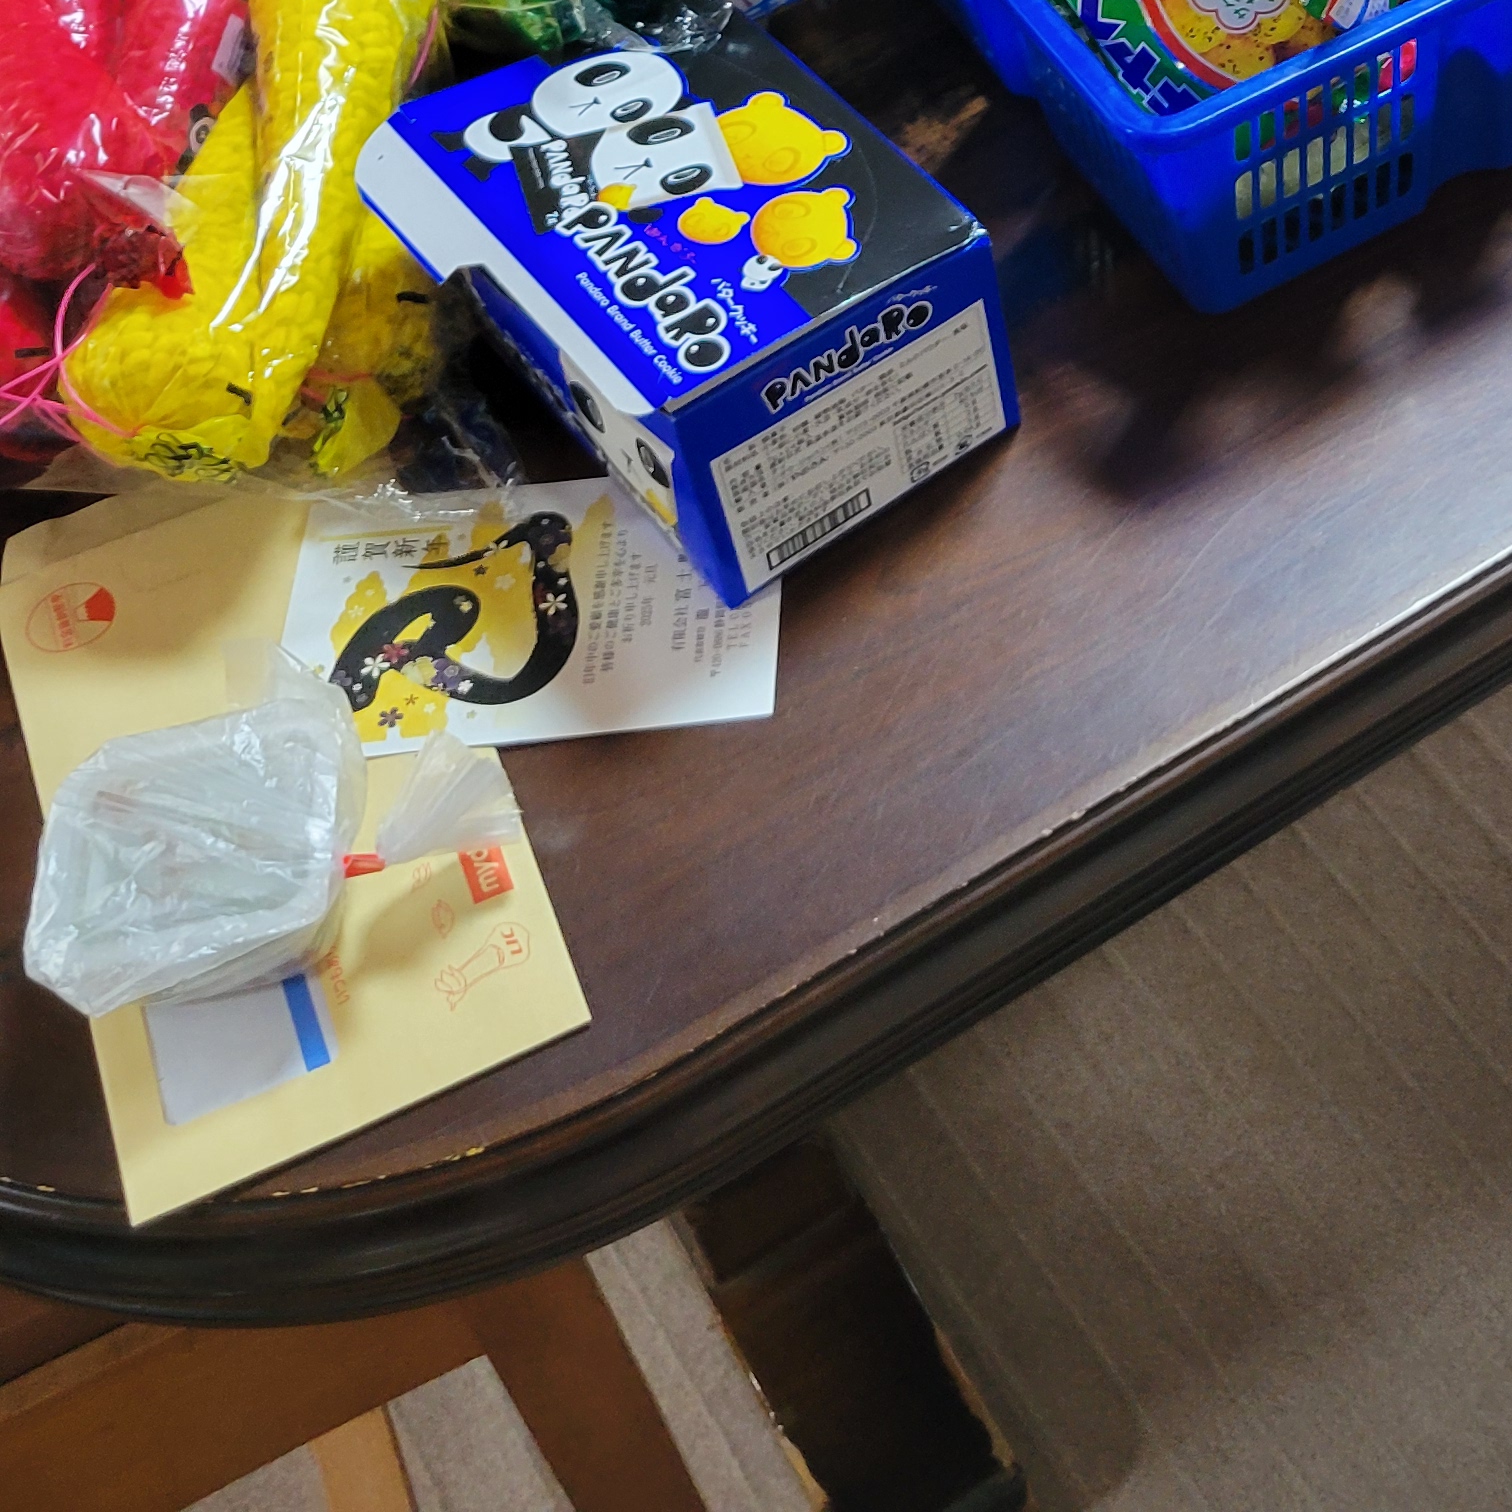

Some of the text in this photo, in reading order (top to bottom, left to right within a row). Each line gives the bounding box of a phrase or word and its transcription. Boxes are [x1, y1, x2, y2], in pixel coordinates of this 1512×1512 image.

[575, 271, 684, 386] Pandaro Brand Butter Cookie
[710, 276, 759, 346] バタークッキー
[333, 533, 450, 566] 謹賀新年
[670, 603, 690, 653] 有限会社
